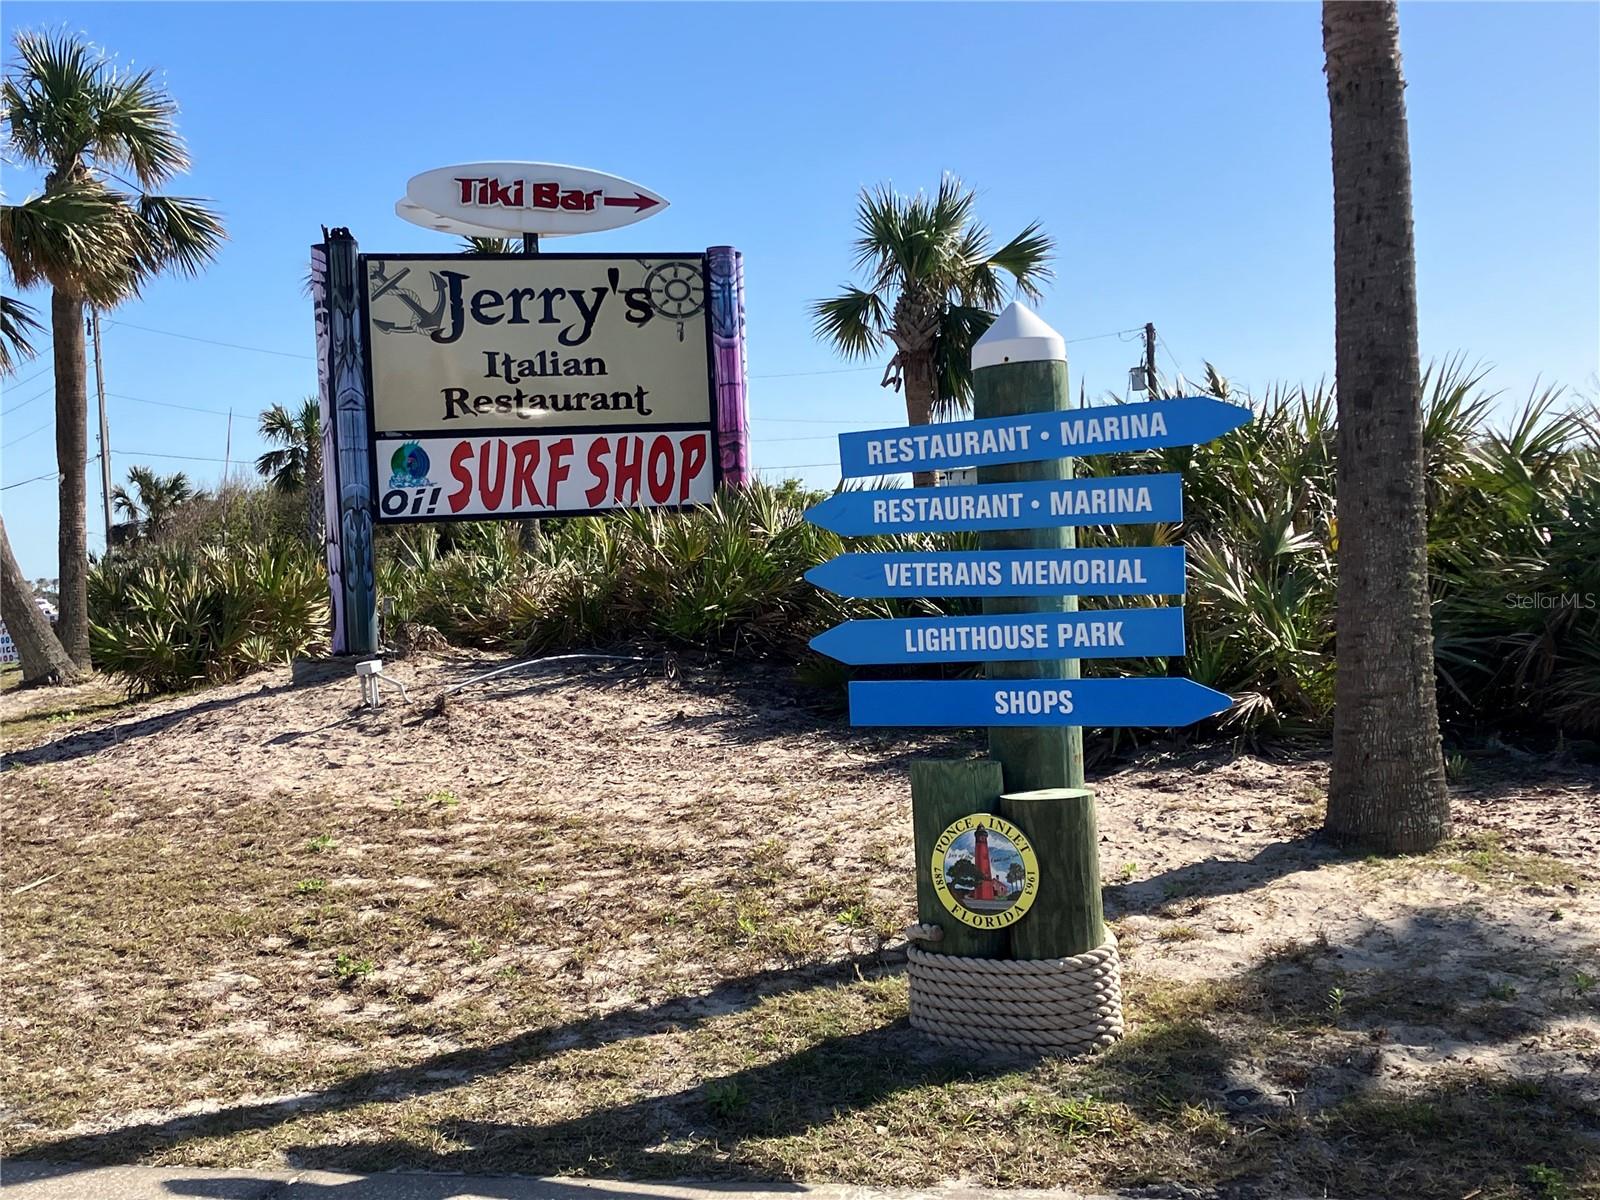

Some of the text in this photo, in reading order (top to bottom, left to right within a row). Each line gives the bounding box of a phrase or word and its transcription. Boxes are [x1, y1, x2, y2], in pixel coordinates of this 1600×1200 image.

[454, 177, 603, 212] Tiki Bar
[430, 267, 654, 346] Jerry's
[482, 350, 608, 384] Italian
[440, 385, 653, 420] Restaurant
[867, 411, 1168, 465] RESTAURANT MARINA
[448, 434, 707, 513] SURF SHOP
[873, 487, 1152, 524] RESTAURANT MARINA
[884, 559, 1147, 587] VETERANS MEMORIAL
[905, 622, 1125, 654] LIGHTHOUSE PARK
[994, 690, 1074, 715] SHOPS
[935, 817, 1031, 854] PONCE INLET
[934, 867, 945, 891] 1887
[1025, 871, 1035, 896] 1963
[951, 904, 1025, 927] FLORIDA
